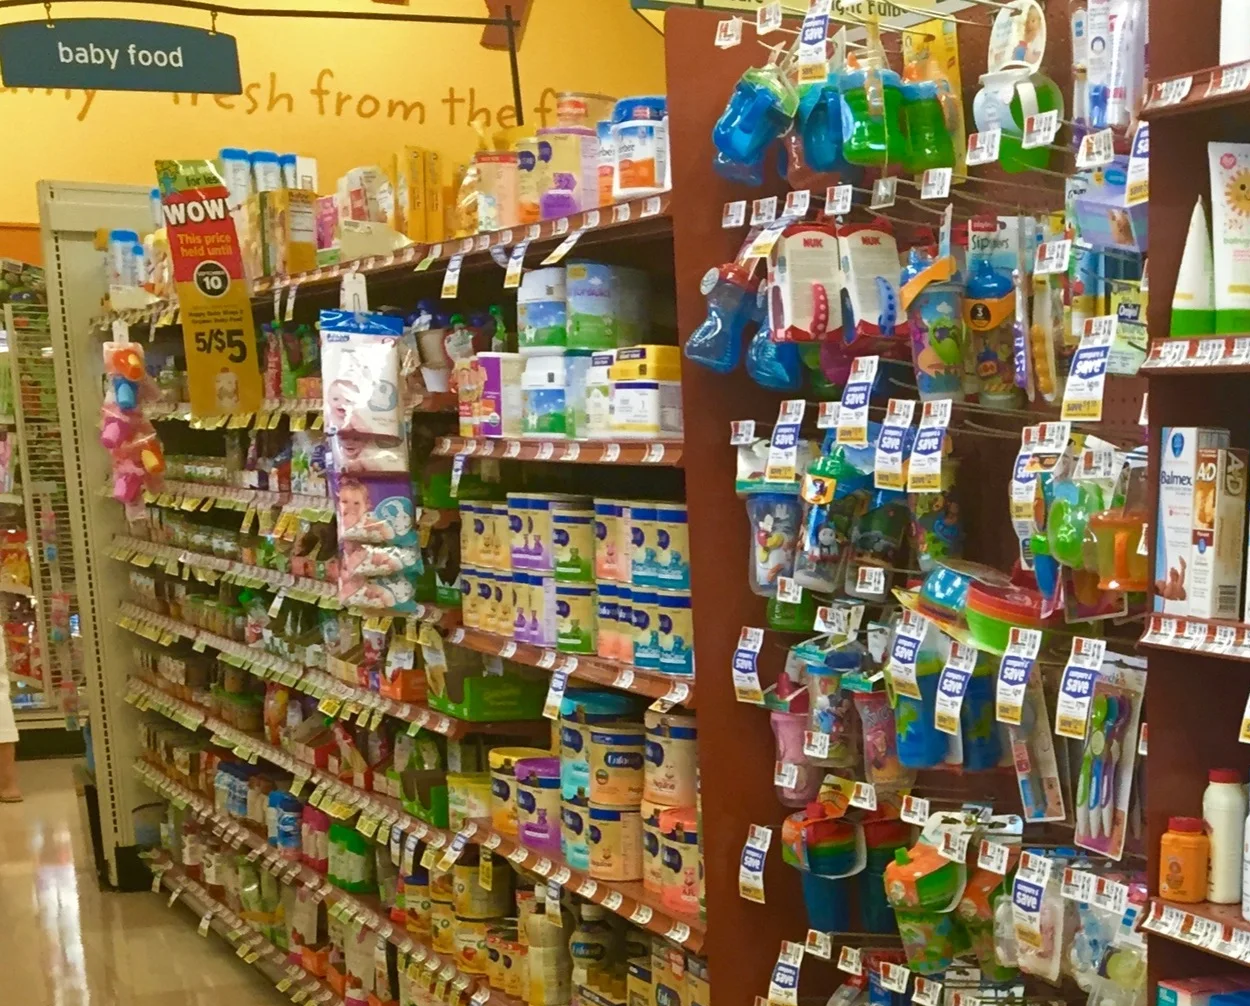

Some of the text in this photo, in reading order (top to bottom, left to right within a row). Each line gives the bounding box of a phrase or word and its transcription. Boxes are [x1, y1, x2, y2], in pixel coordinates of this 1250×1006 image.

[57, 42, 184, 69] baby food
[310, 68, 426, 117] from
[441, 87, 517, 128] the
[177, 232, 232, 246] This price
[803, 238, 823, 248] NUK
[861, 236, 881, 246] NUK
[181, 245, 233, 257] held until
[202, 276, 222, 291] 10
[1160, 471, 1192, 485] Balmex
